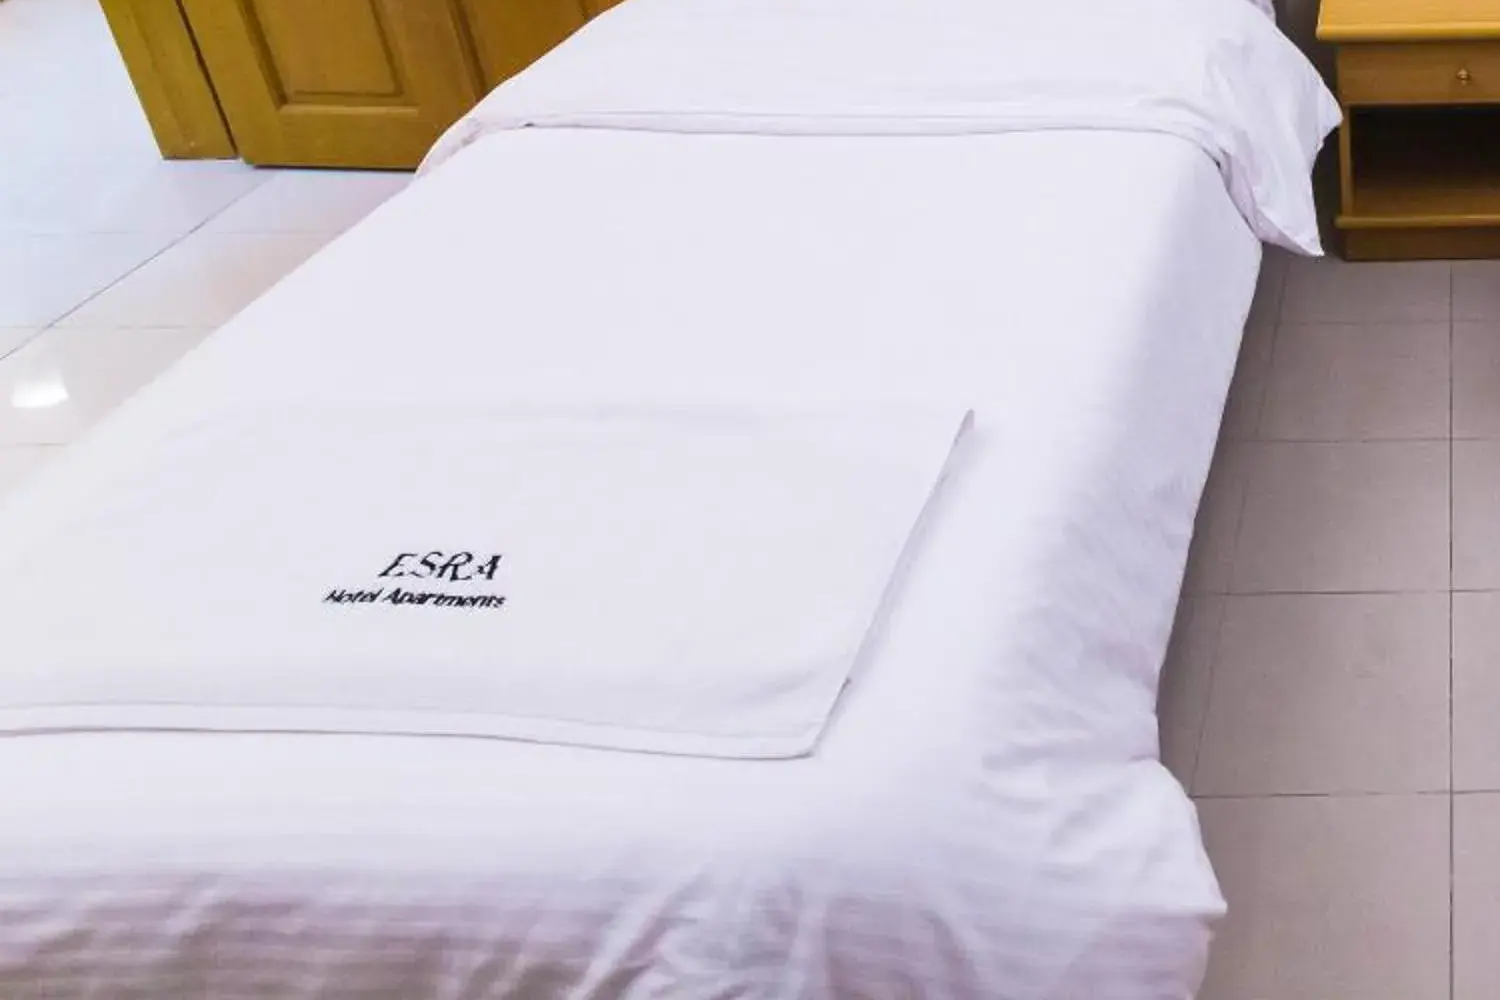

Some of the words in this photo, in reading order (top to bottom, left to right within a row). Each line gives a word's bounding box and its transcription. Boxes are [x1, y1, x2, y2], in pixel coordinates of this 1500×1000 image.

[378, 550, 502, 582] ESRA
[325, 588, 385, 605] Hotel
[383, 587, 507, 609] Apartments
